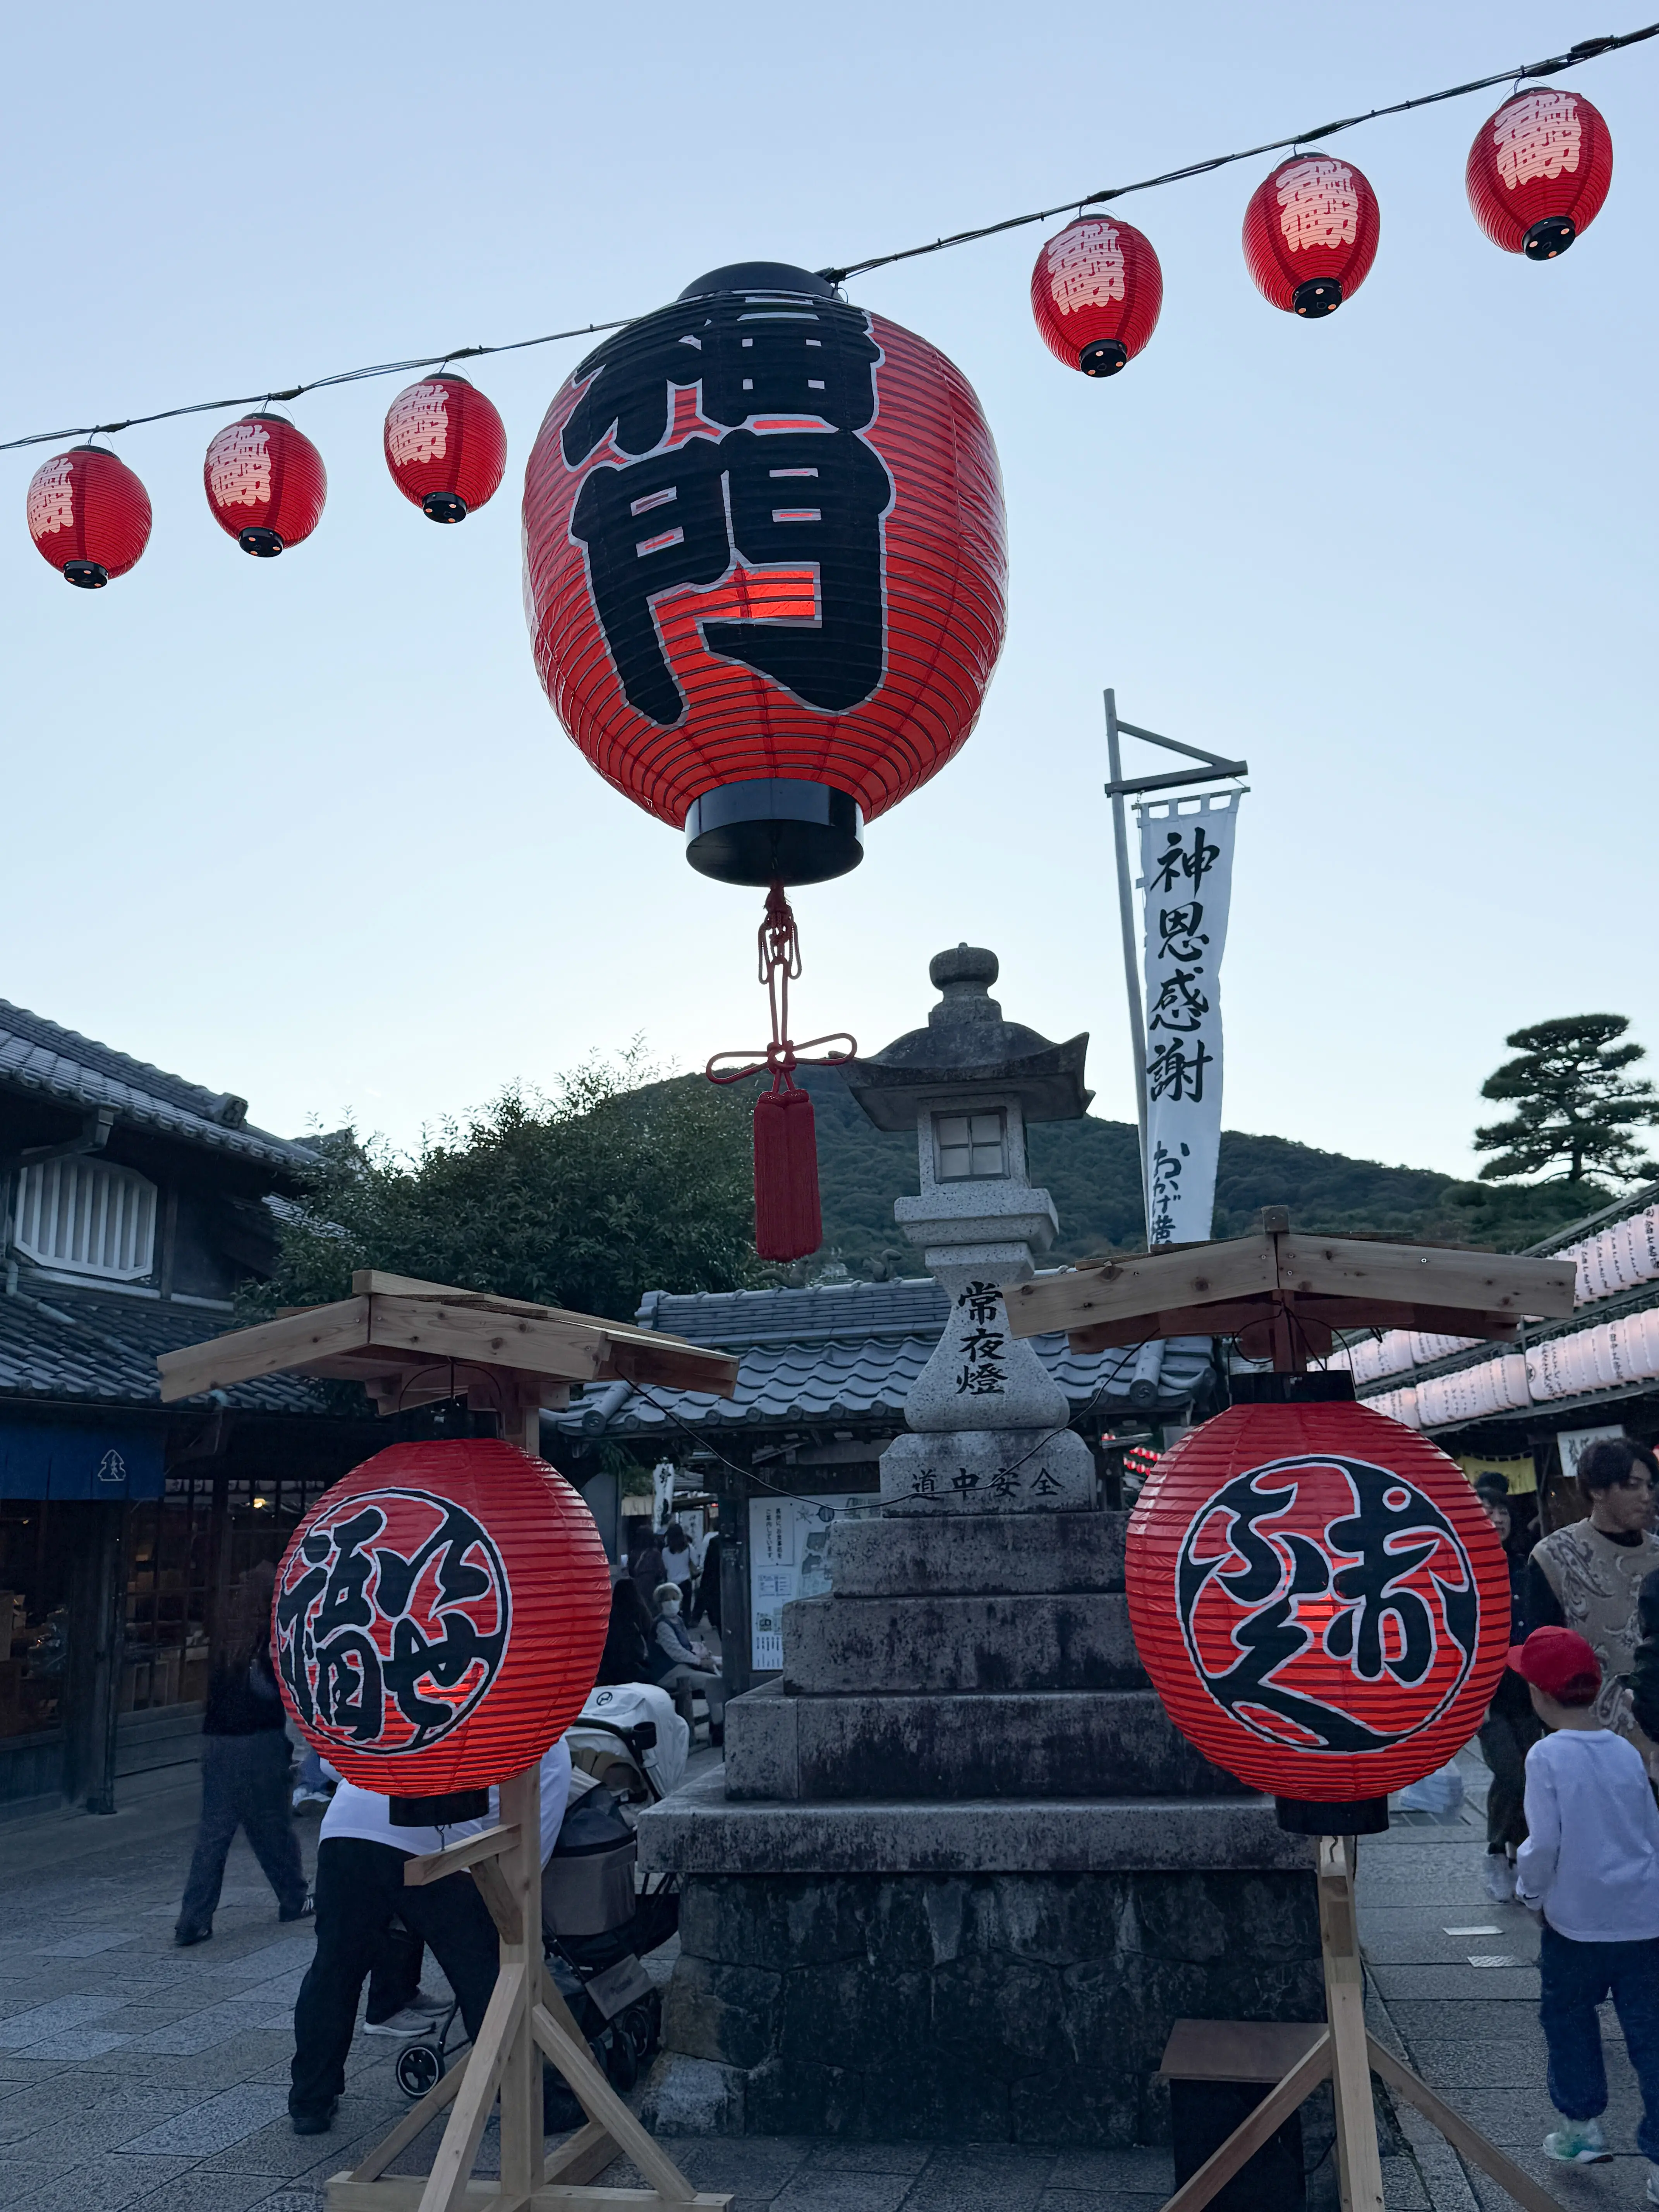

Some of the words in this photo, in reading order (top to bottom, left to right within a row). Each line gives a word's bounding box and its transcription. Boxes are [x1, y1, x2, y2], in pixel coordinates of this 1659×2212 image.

[1146, 826, 1220, 1103] 神恩感謝
[955, 1281, 1008, 1396] 常夜燈
[911, 1467, 1065, 1501] 道中安全
